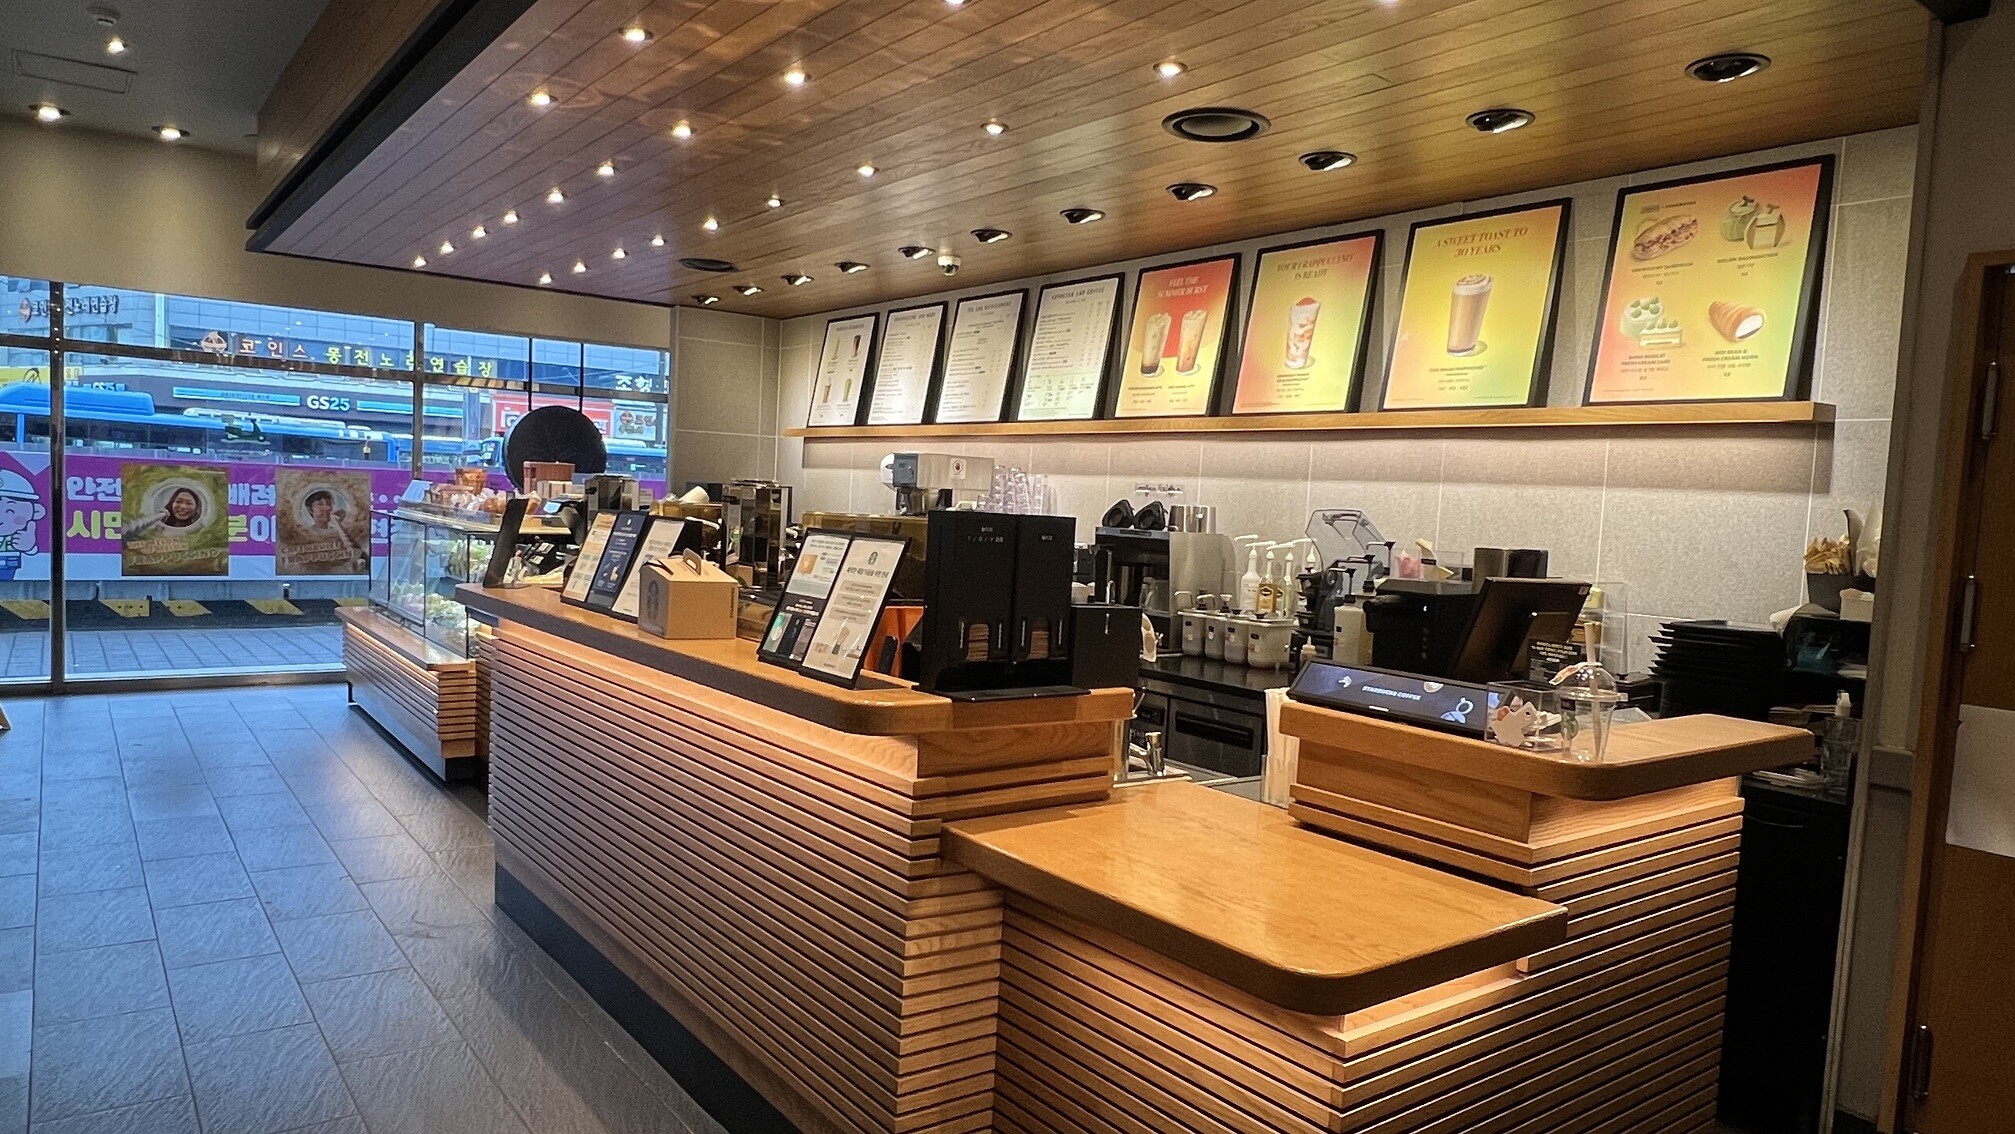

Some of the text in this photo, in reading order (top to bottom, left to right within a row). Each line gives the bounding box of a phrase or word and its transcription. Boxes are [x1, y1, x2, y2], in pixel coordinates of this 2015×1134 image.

[1443, 234, 1477, 247] SWEET
[1479, 229, 1512, 243] TOAST
[1514, 227, 1529, 237] TO
[1468, 245, 1502, 257] YEARS
[1302, 269, 1329, 279] READY
[1168, 278, 1184, 288] FEEL
[240, 338, 308, 358] 코인스
[306, 395, 350, 411] GS25
[1398, 691, 1421, 701] COFFEE
